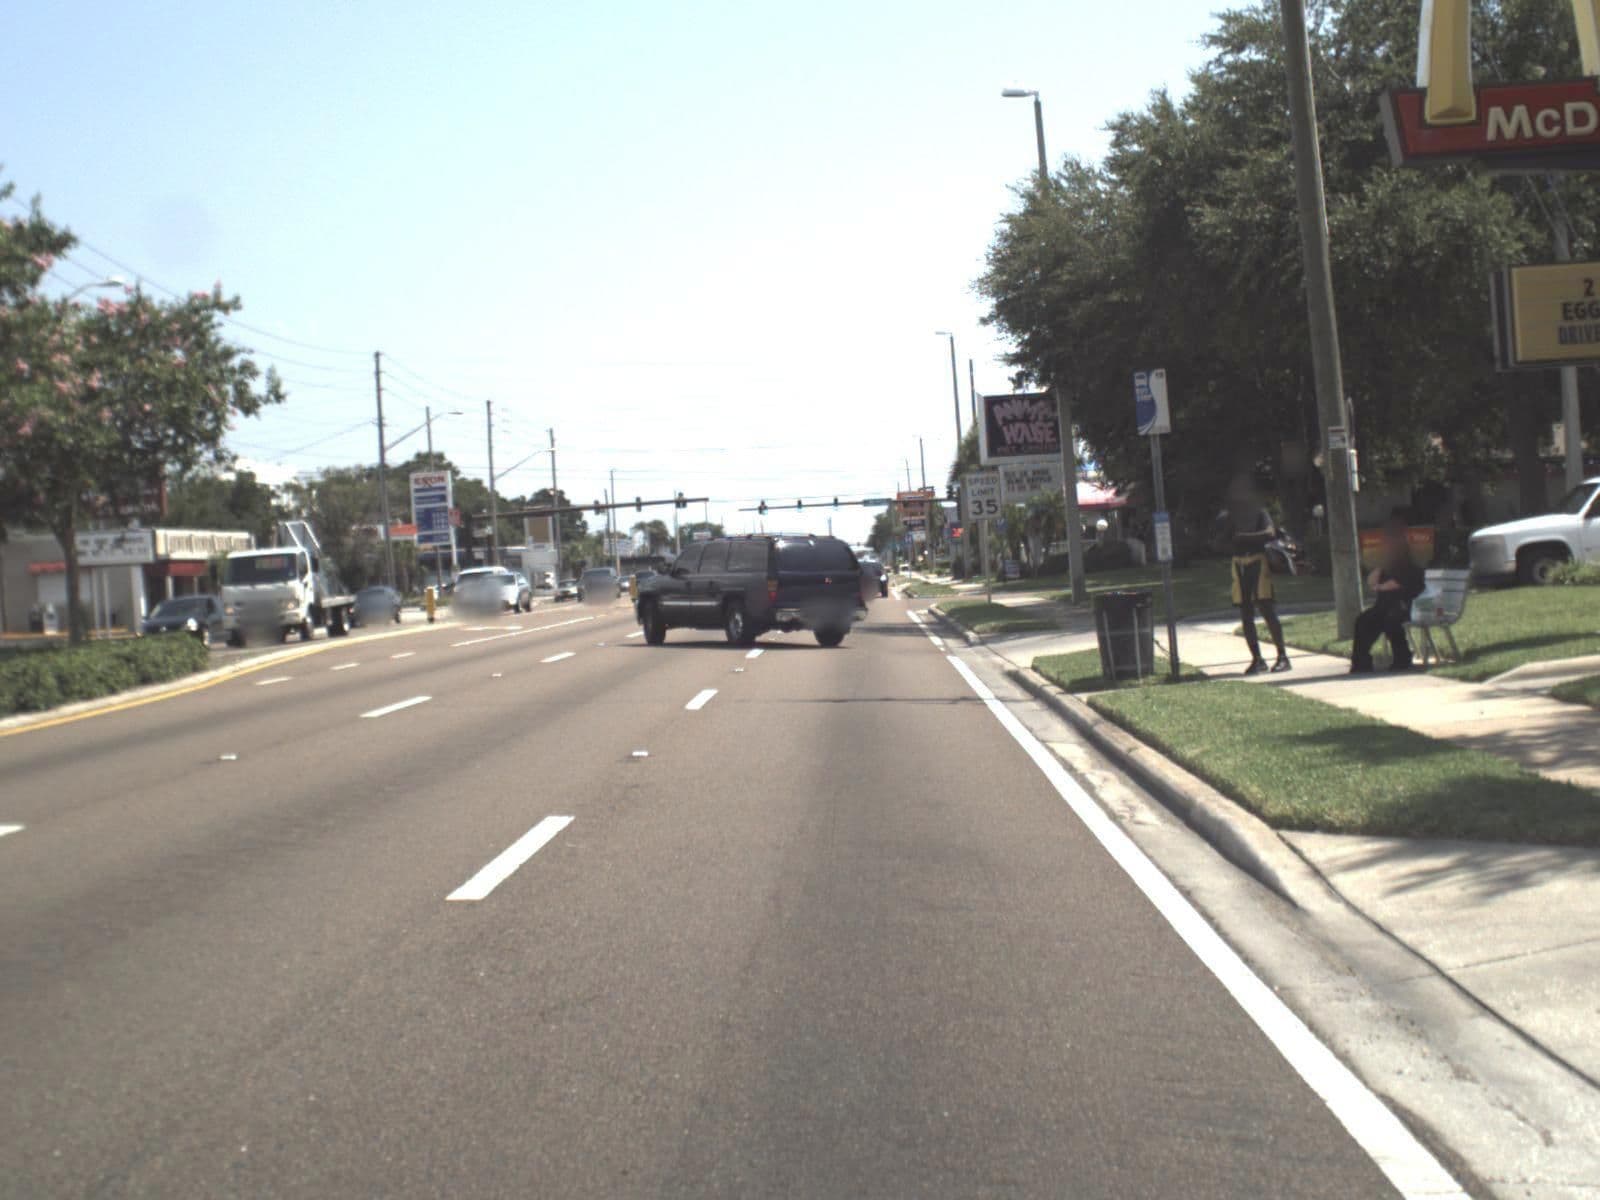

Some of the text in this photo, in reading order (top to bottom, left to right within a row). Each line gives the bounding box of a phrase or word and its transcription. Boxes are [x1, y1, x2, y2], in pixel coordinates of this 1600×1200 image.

[1583, 278, 1595, 296] 2
[1003, 420, 1056, 445] HOUSE
[968, 477, 997, 485] SPEED
[971, 487, 995, 497] LIMIT
[971, 500, 998, 515] 35
